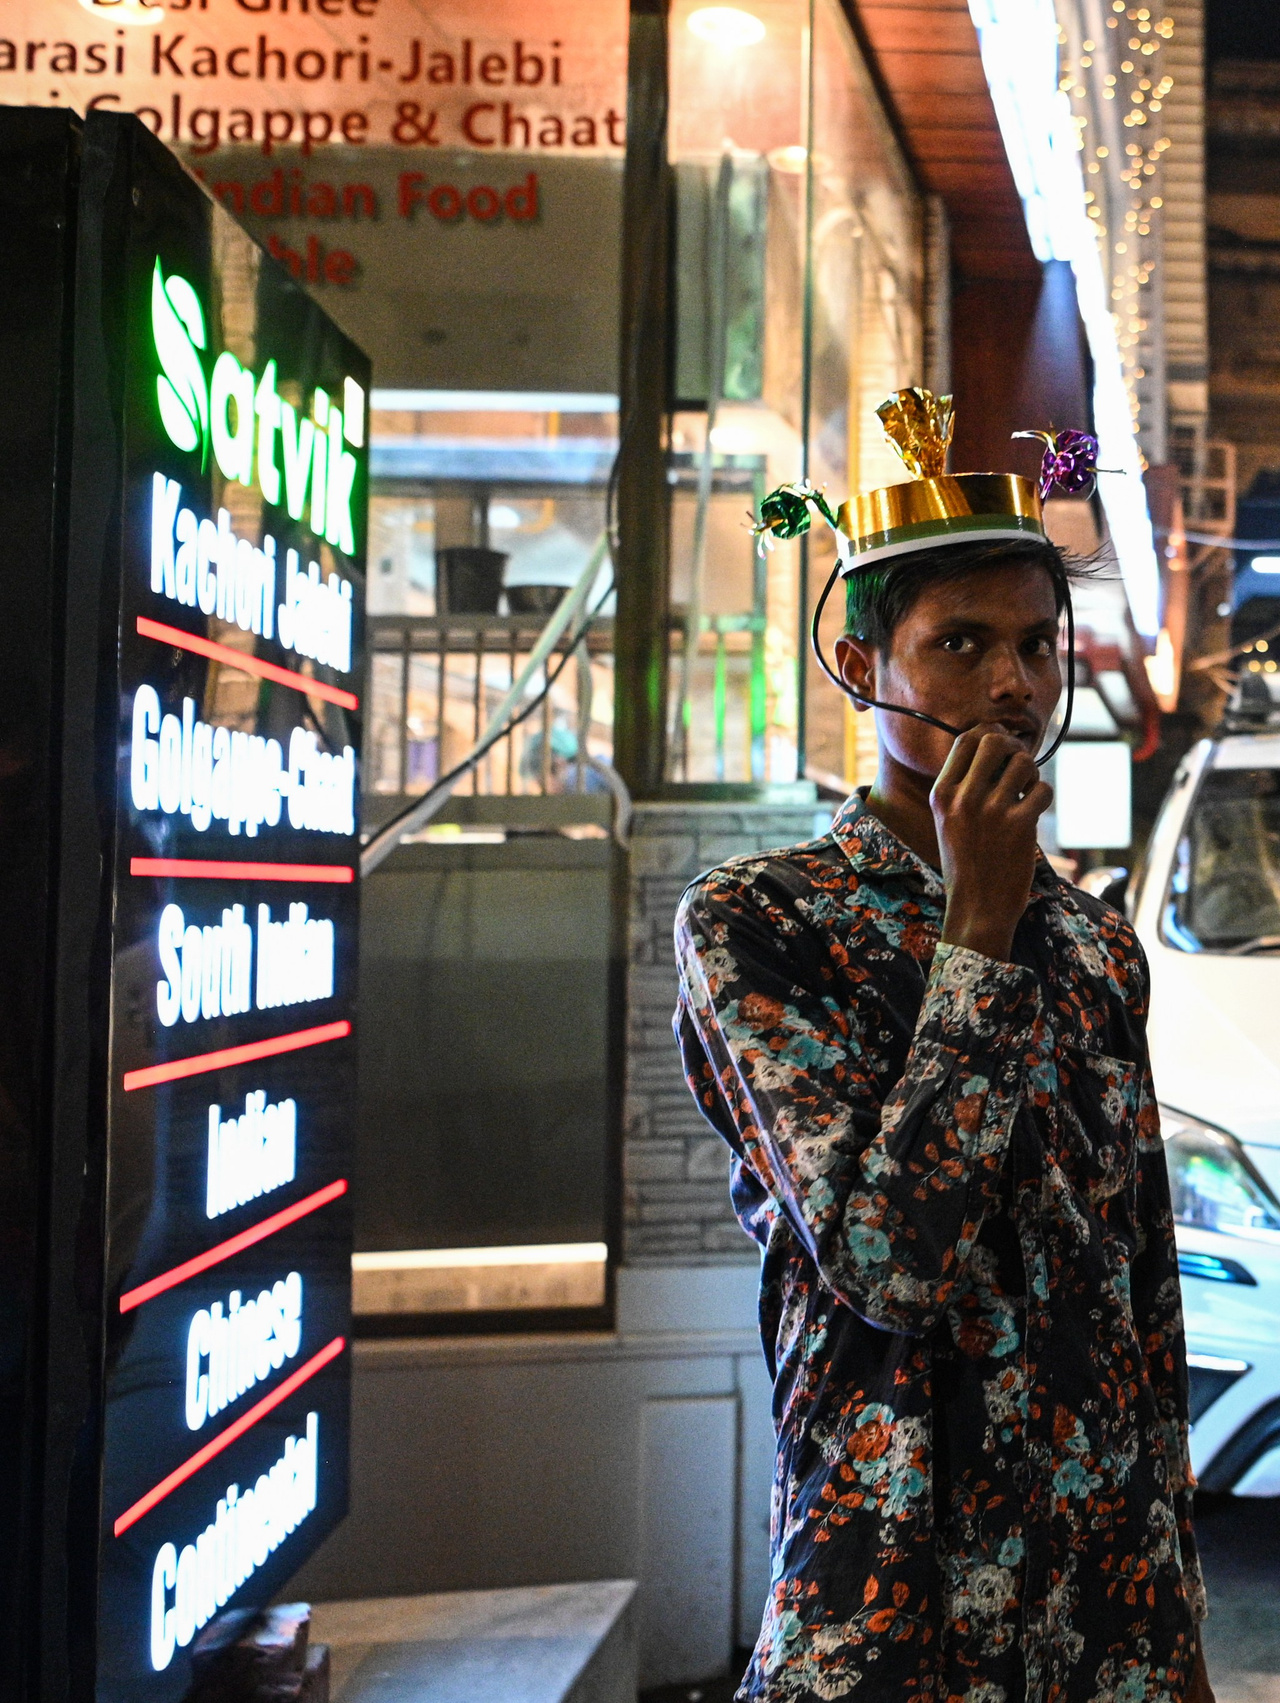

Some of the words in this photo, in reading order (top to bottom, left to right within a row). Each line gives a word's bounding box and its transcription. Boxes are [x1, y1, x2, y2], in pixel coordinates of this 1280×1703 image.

[151, 33, 563, 86] Kachori-Jalebi
[391, 101, 439, 146] &
[461, 103, 626, 148] Chaat
[190, 167, 376, 217] ndian
[398, 170, 538, 221] Food
[151, 254, 358, 557] Satvik
[156, 903, 252, 1027] South
